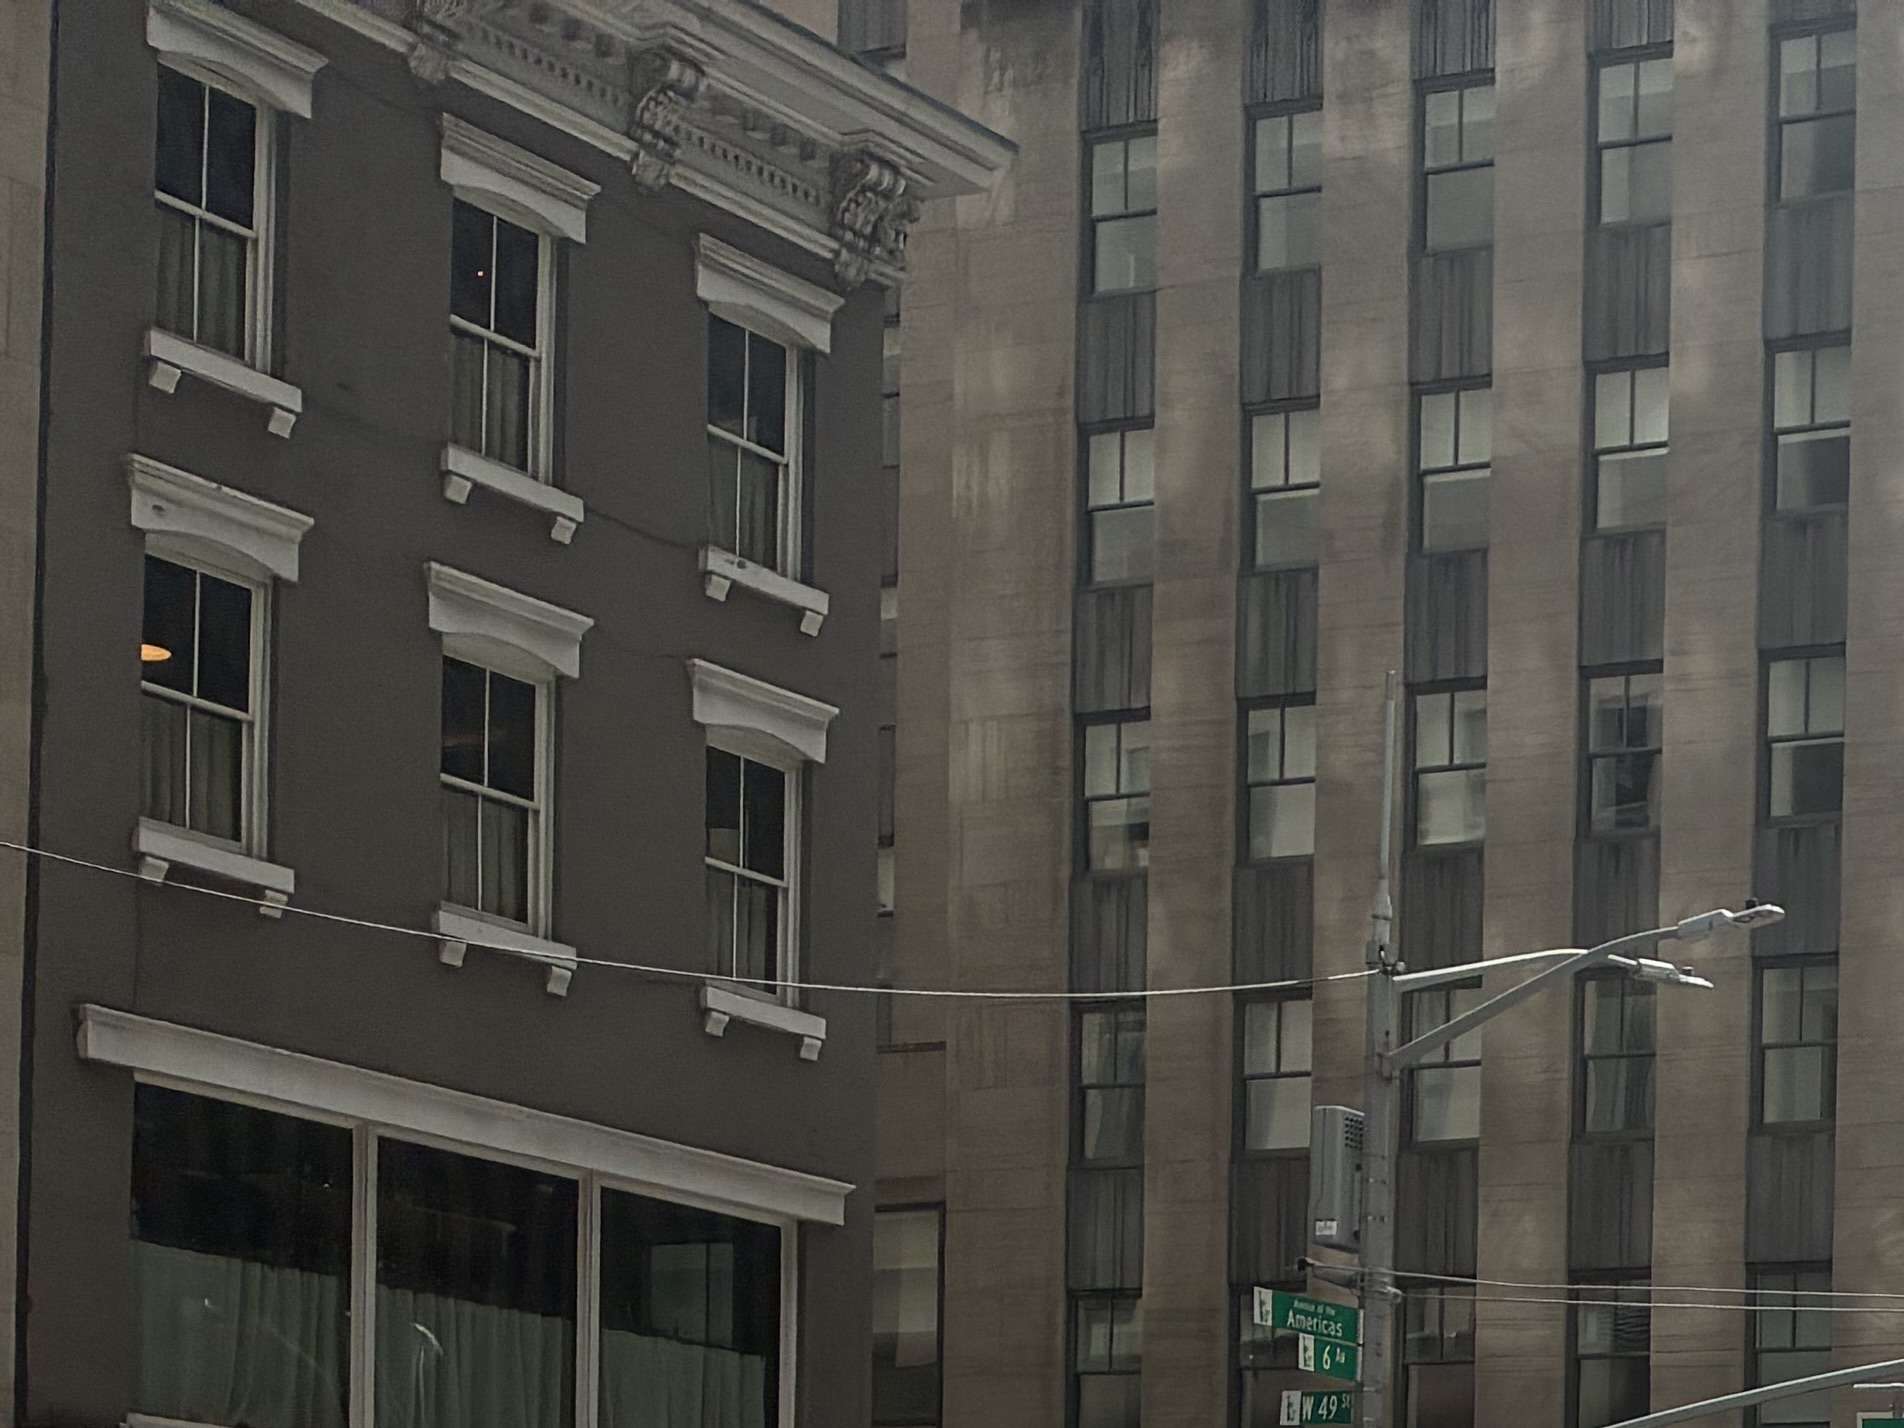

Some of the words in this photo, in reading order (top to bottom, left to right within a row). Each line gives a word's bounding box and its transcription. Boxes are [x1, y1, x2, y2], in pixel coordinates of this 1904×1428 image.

[1287, 1308, 1344, 1337] Americas
[1322, 1345, 1331, 1370] 6
[1302, 1395, 1315, 1421] W
[1317, 1395, 1338, 1420] 49
